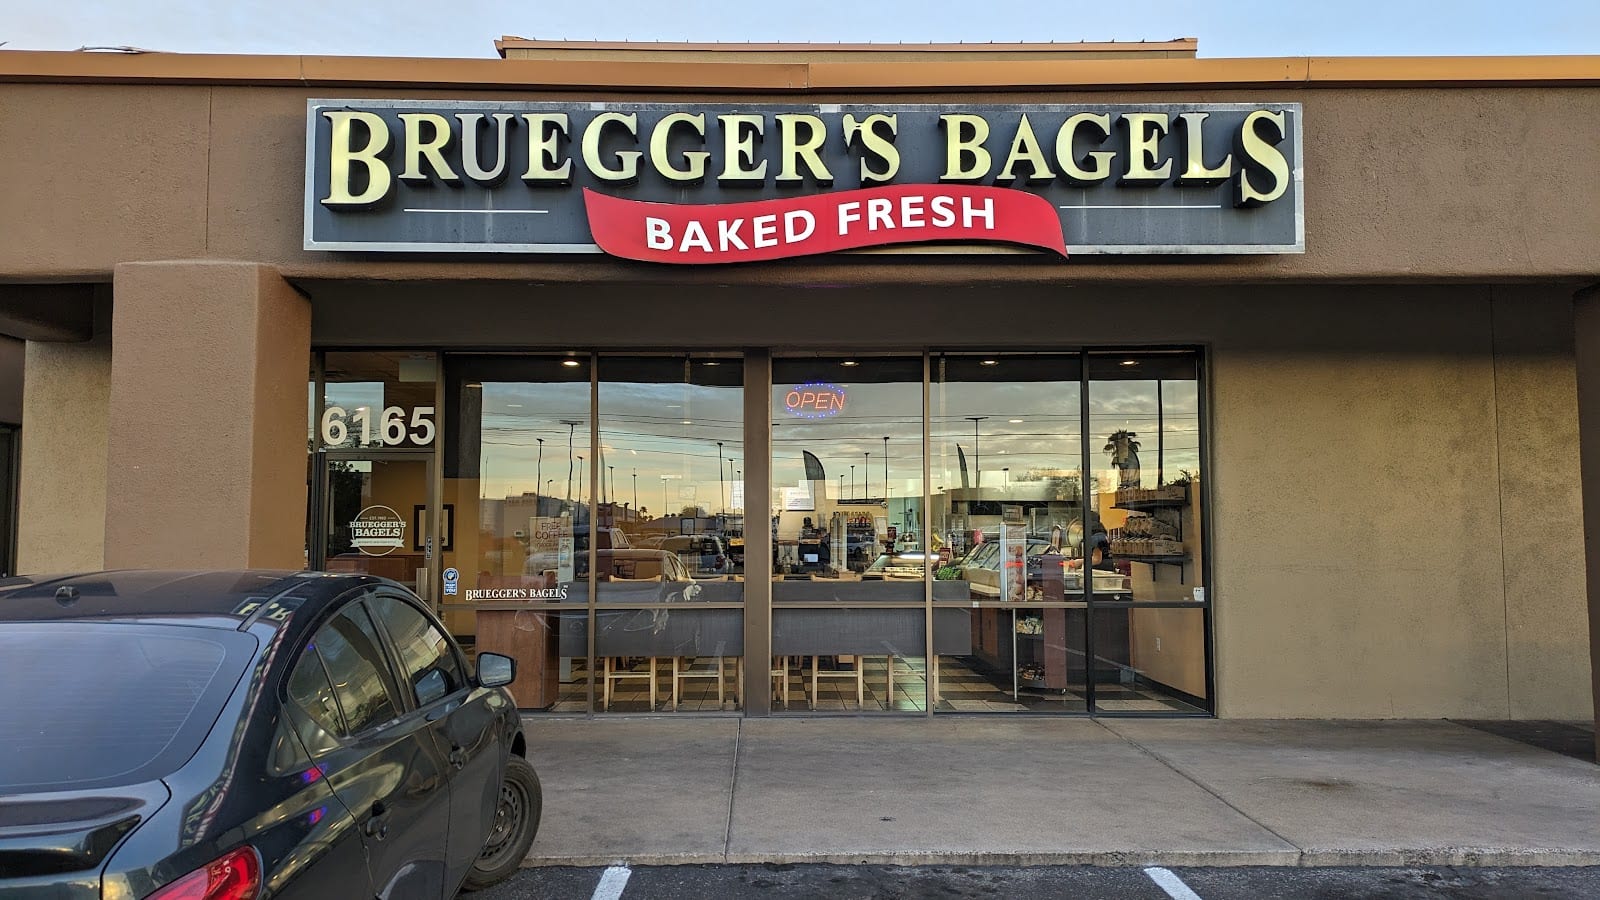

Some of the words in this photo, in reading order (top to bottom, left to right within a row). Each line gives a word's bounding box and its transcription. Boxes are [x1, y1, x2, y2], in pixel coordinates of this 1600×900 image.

[320, 110, 901, 206] BRUEGGER'S
[938, 109, 1290, 204] BAGELS
[645, 209, 816, 253] BAKED
[837, 195, 995, 236] FRESH
[785, 391, 846, 410] OPEN
[321, 406, 436, 446] 6165
[355, 528, 401, 537] BAGELS
[465, 588, 527, 601] BRUEGGER'S
[529, 588, 568, 600] BAGELS
